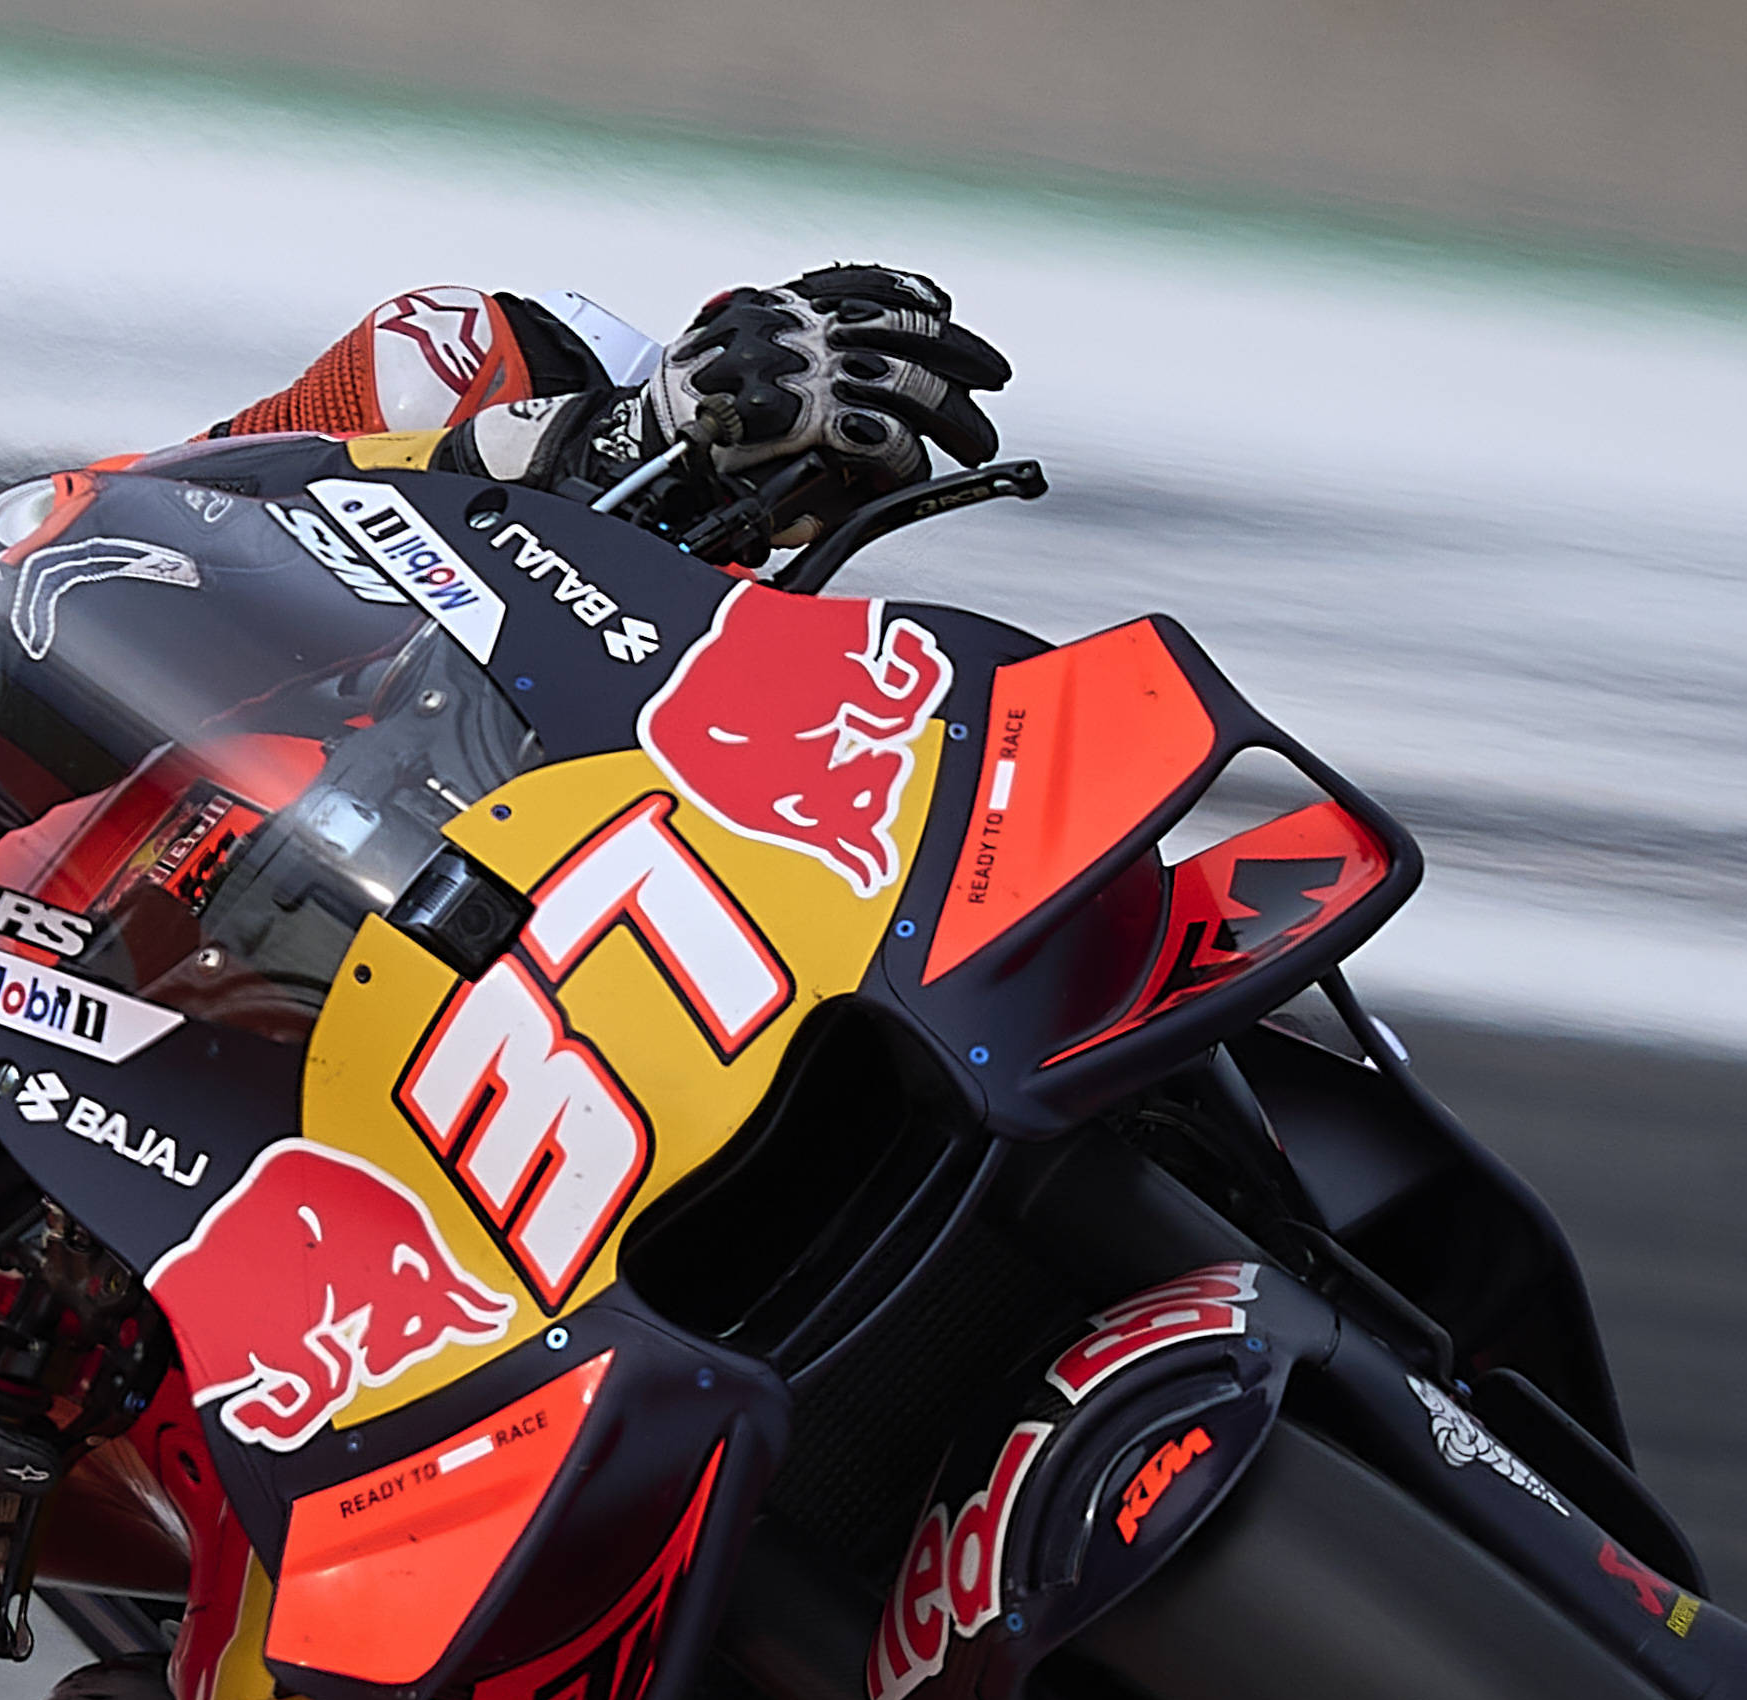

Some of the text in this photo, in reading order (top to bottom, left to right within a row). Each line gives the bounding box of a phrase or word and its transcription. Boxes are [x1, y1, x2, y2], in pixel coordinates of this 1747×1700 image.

[384, 536, 479, 611] Mobil
[490, 524, 619, 627] BAJAJ
[968, 708, 1027, 905] READY TO RACE
[392, 791, 797, 1318] 37
[65, 1096, 209, 1187] BAJAJ
[340, 1411, 549, 1519] READY TO RACE
[1116, 1427, 1213, 1544] KTM
